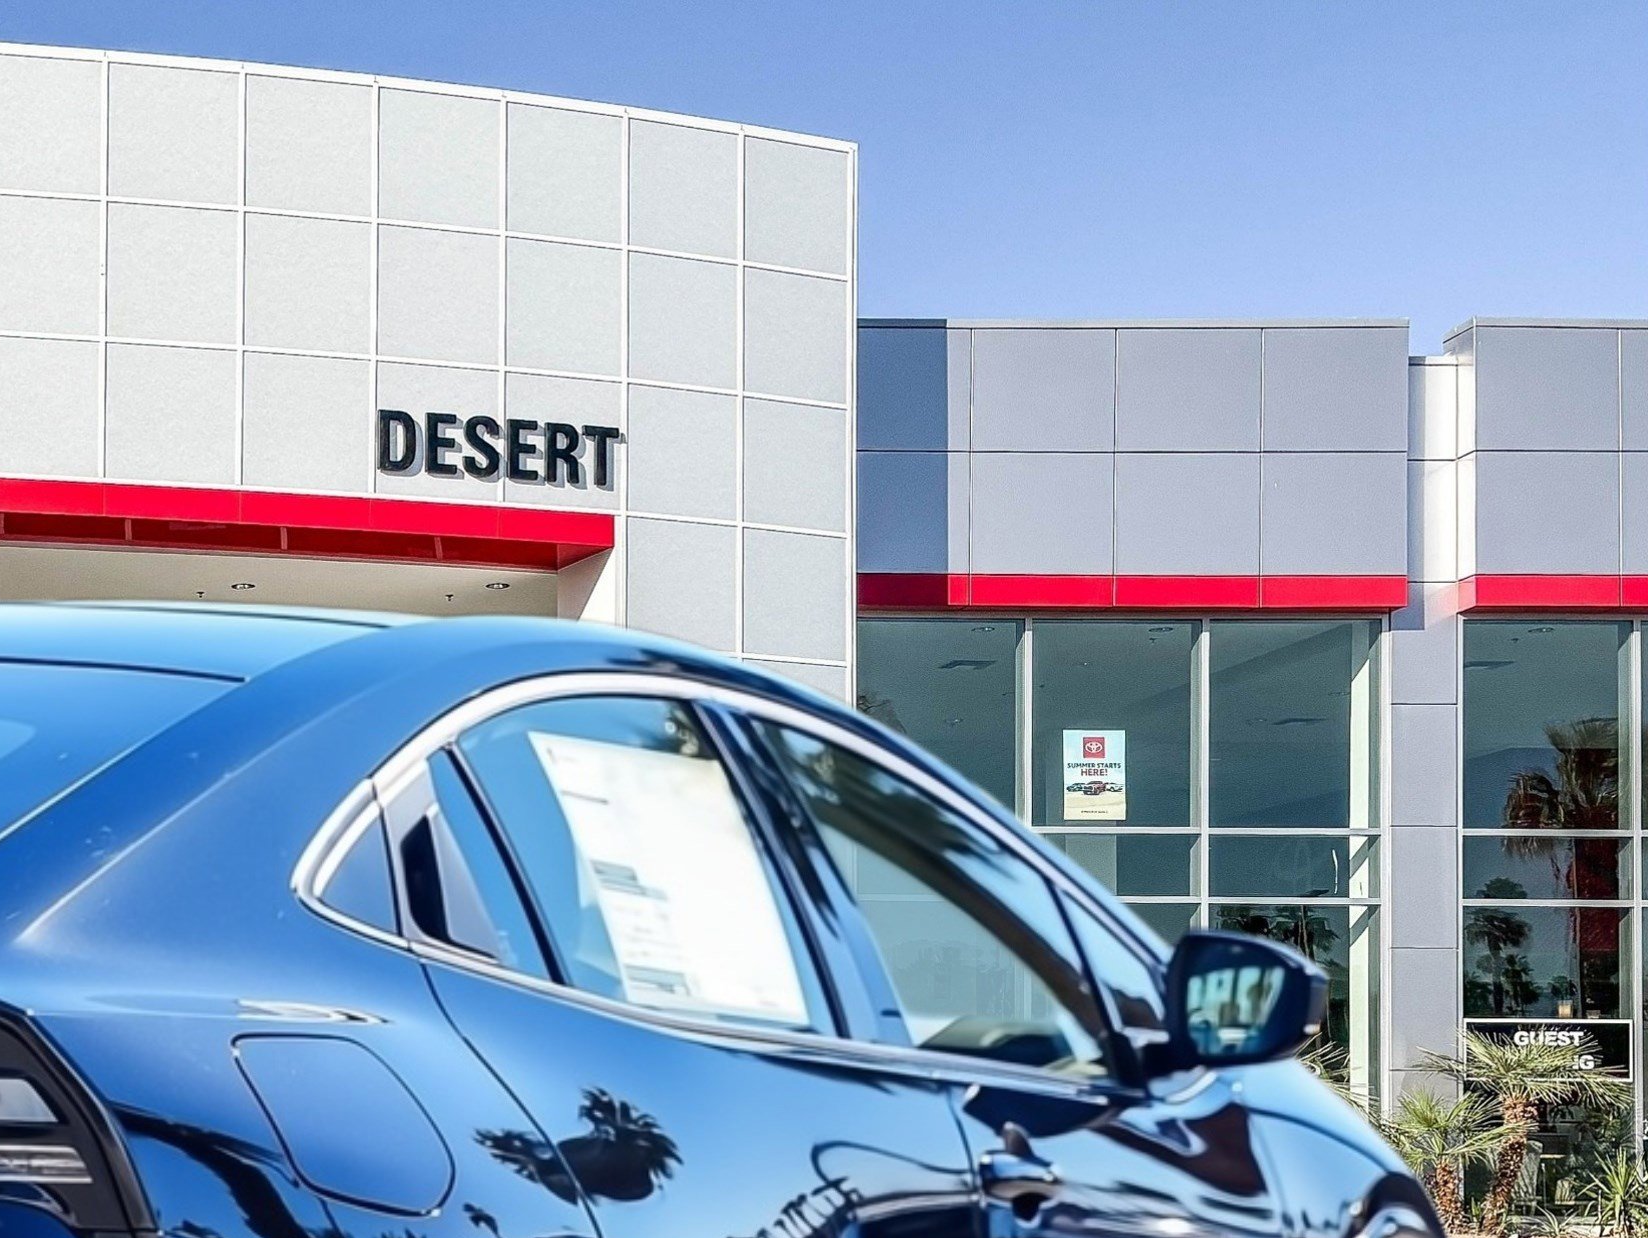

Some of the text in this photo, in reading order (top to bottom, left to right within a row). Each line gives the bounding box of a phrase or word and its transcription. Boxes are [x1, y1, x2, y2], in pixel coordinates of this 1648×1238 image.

[377, 408, 620, 487] DESERT
[1080, 768, 1108, 776] HERE!
[1513, 1030, 1585, 1047] GUEST
